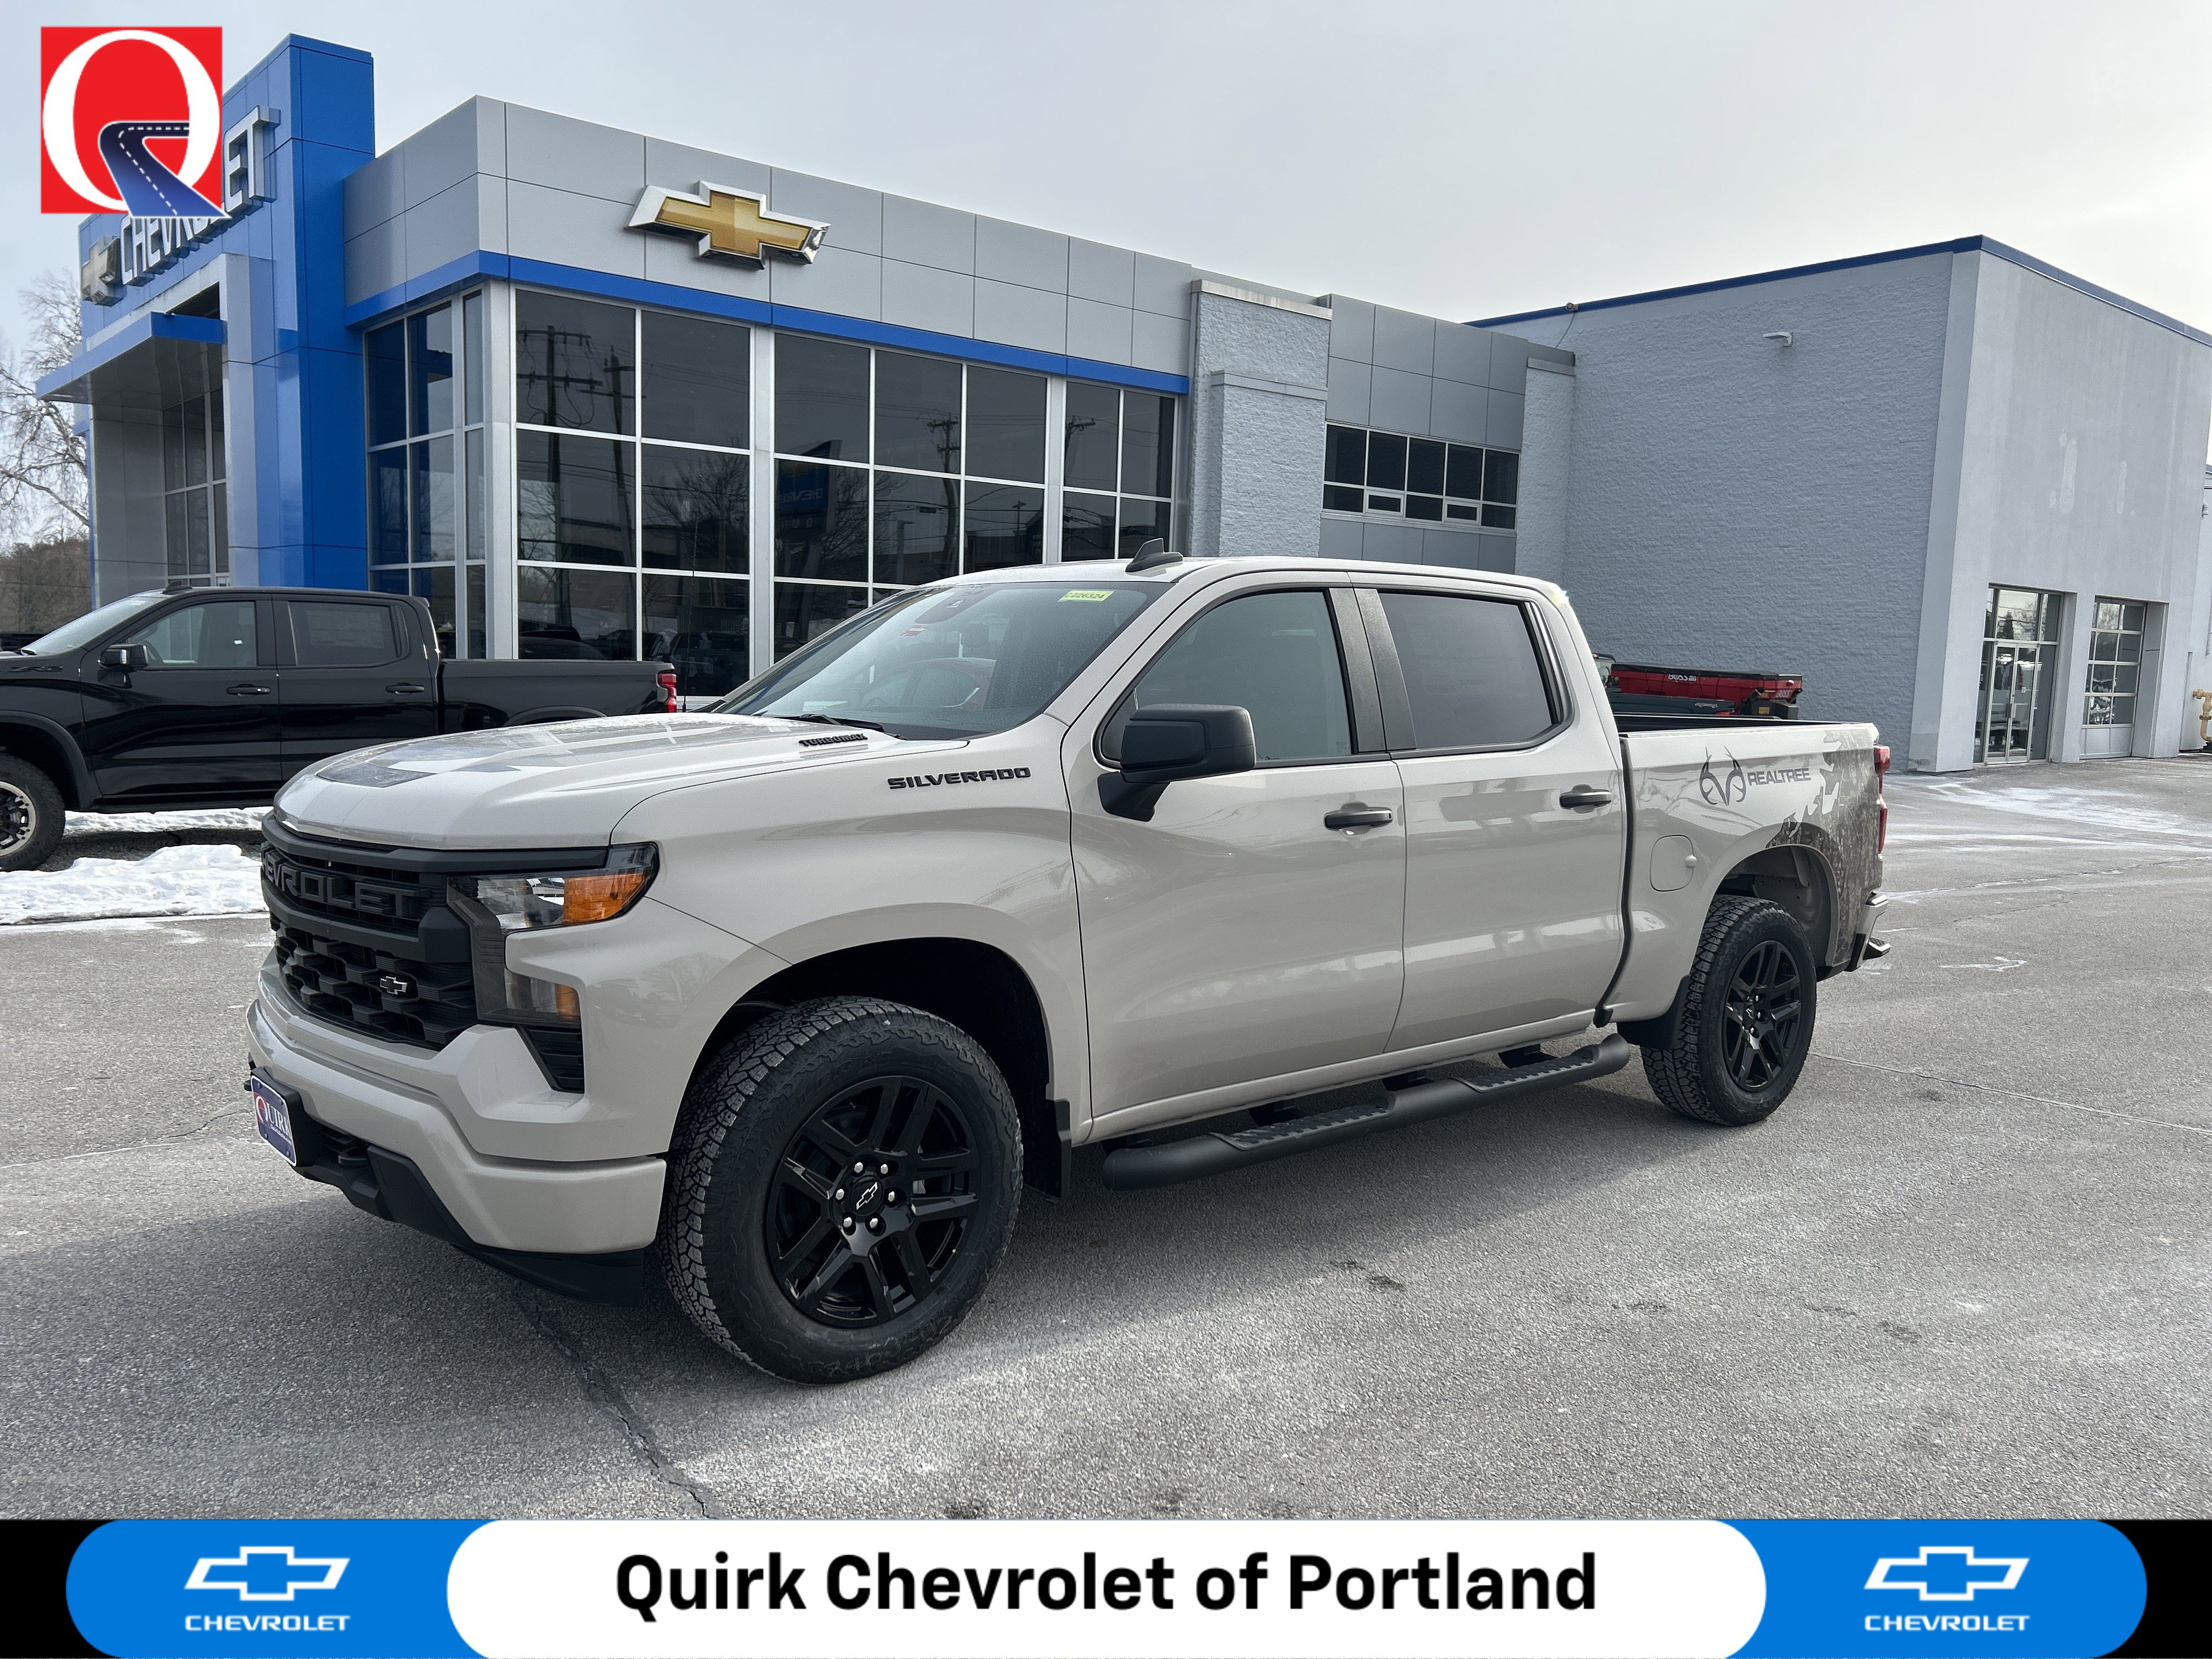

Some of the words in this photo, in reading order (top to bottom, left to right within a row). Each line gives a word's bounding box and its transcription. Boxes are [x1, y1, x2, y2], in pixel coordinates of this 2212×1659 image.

[798, 733, 868, 747] TURBOMAX
[888, 767, 1031, 789] SILVERADO
[1747, 768, 1812, 786] REALTREE
[263, 850, 426, 917] EVROLET
[255, 1096, 292, 1141] QUIRK
